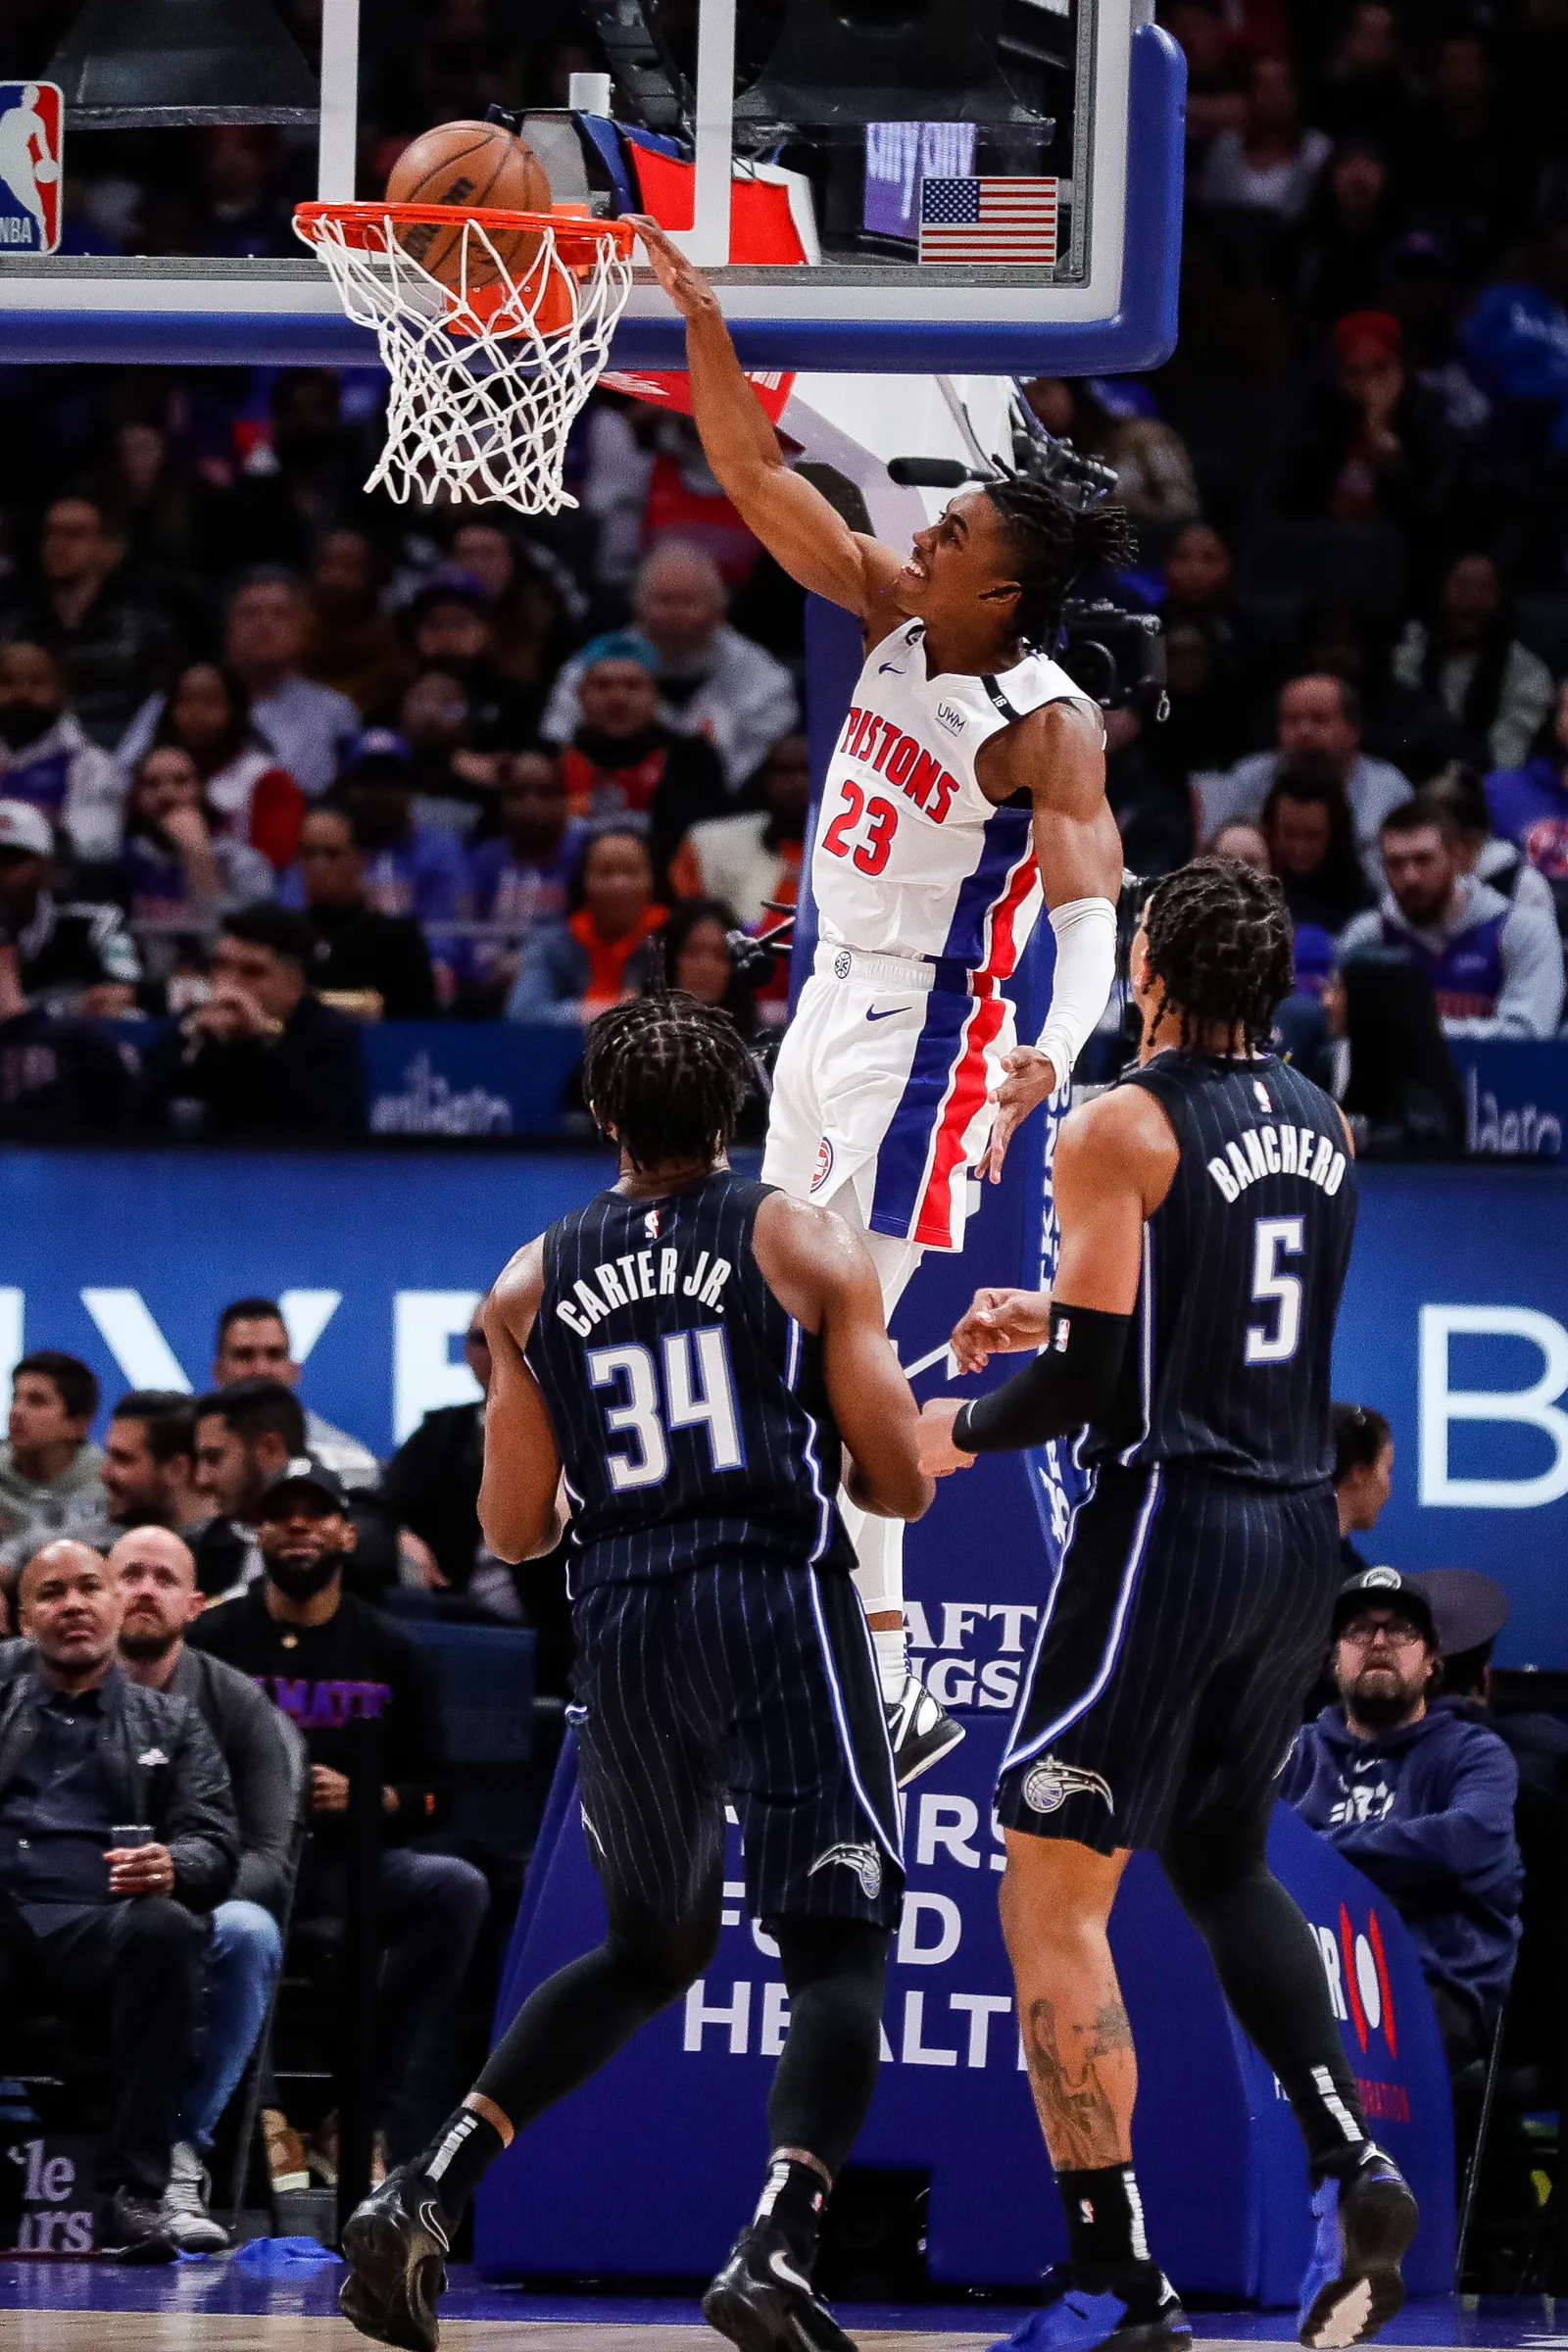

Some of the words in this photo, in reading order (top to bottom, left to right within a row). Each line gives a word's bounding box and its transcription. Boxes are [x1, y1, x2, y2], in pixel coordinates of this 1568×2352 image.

[841, 707, 960, 824] PISTONS
[937, 702, 967, 733] UWM
[821, 779, 899, 876] 23
[1206, 1124, 1347, 1203] BANCHERO
[556, 1248, 678, 1338] CARTER
[682, 1250, 732, 1314] JR.
[1244, 1214, 1306, 1367] 5
[584, 1323, 748, 1494] 34
